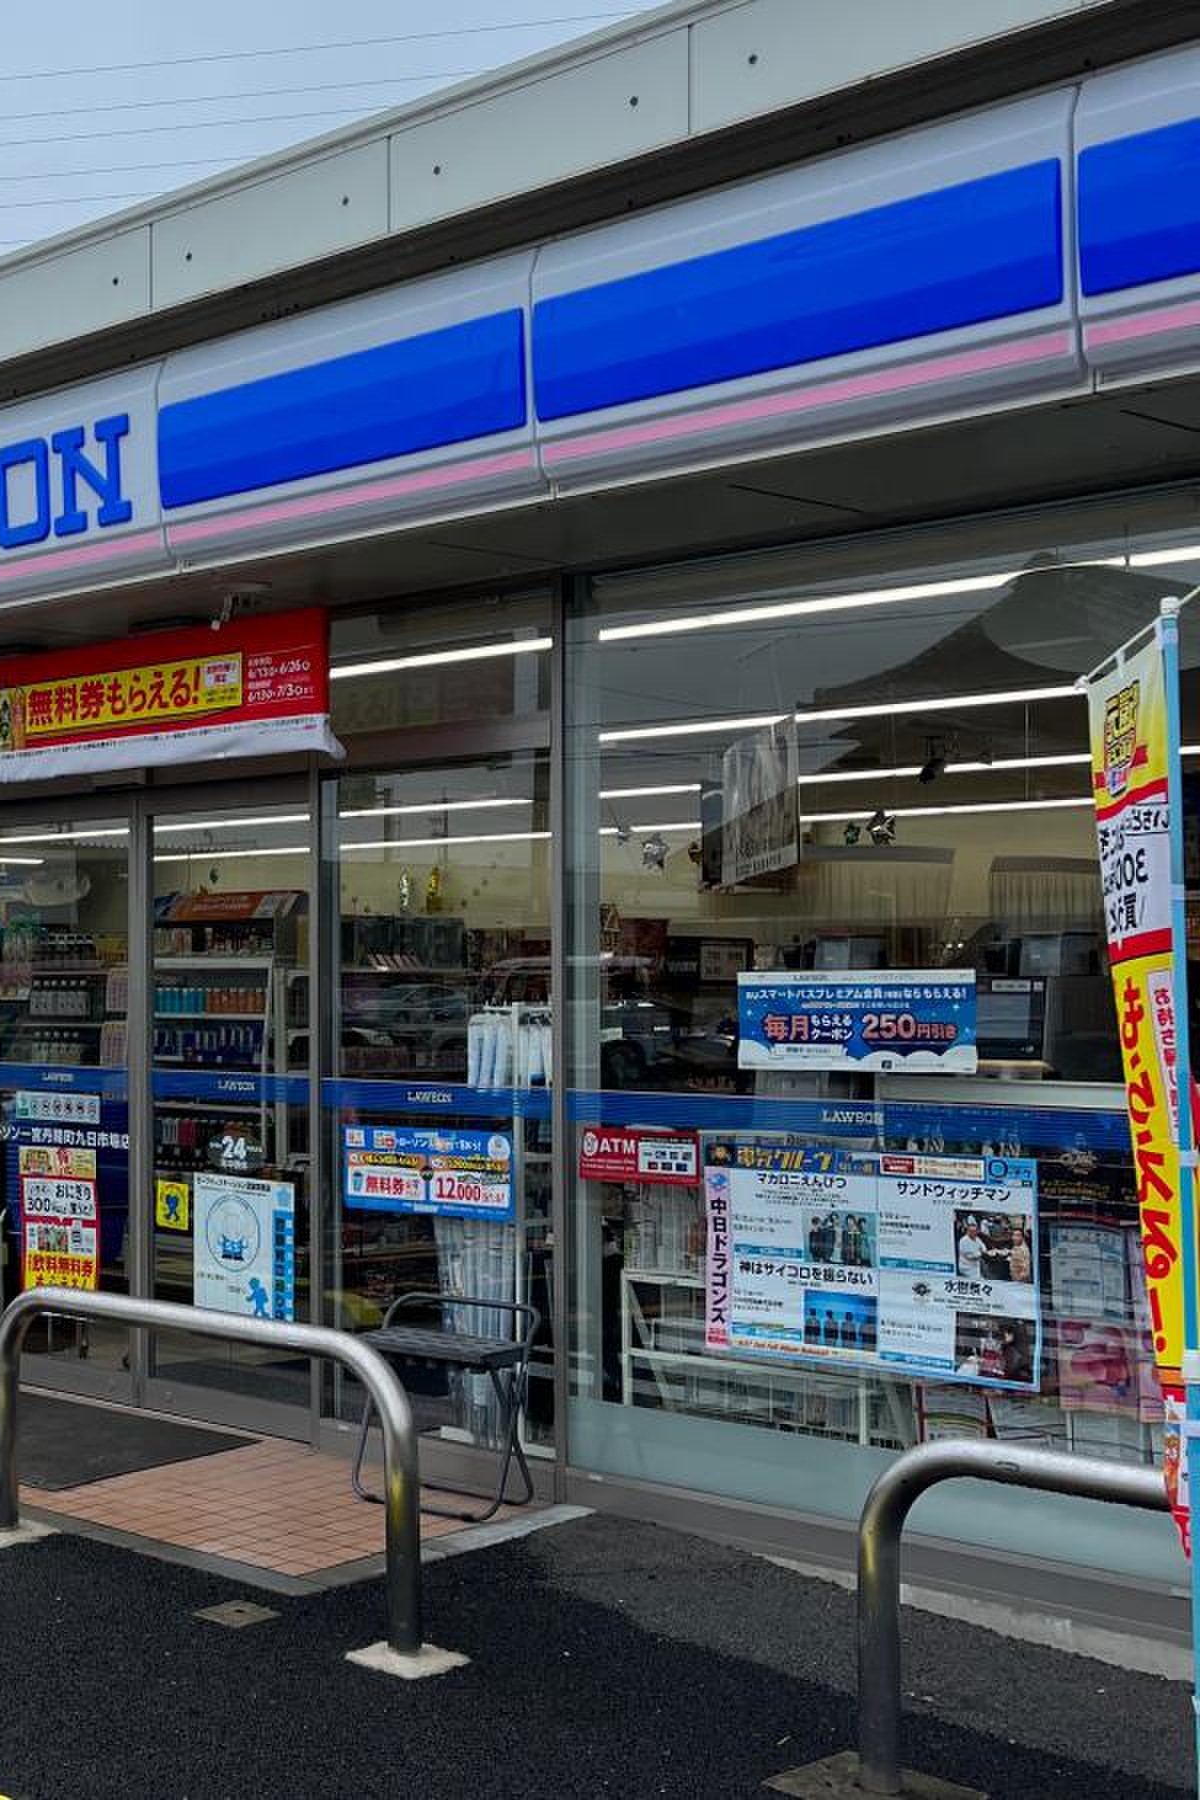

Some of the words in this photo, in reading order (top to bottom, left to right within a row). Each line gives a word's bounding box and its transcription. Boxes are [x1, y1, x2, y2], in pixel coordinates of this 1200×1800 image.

[29, 666, 200, 726] 無料券もらえる!
[764, 1014, 809, 1041] 毎月
[811, 1028, 853, 1041] クーポン
[822, 1108, 883, 1126] LAWSON
[221, 1135, 247, 1159] 24
[600, 1137, 636, 1154] ATM
[756, 1172, 848, 1189] マカロニえんぴつ
[897, 1181, 1011, 1201] サンドウィッチマン
[710, 1198, 728, 1324] 中日ドラゴンズ
[739, 1261, 874, 1285] 神はサイコロを振らない
